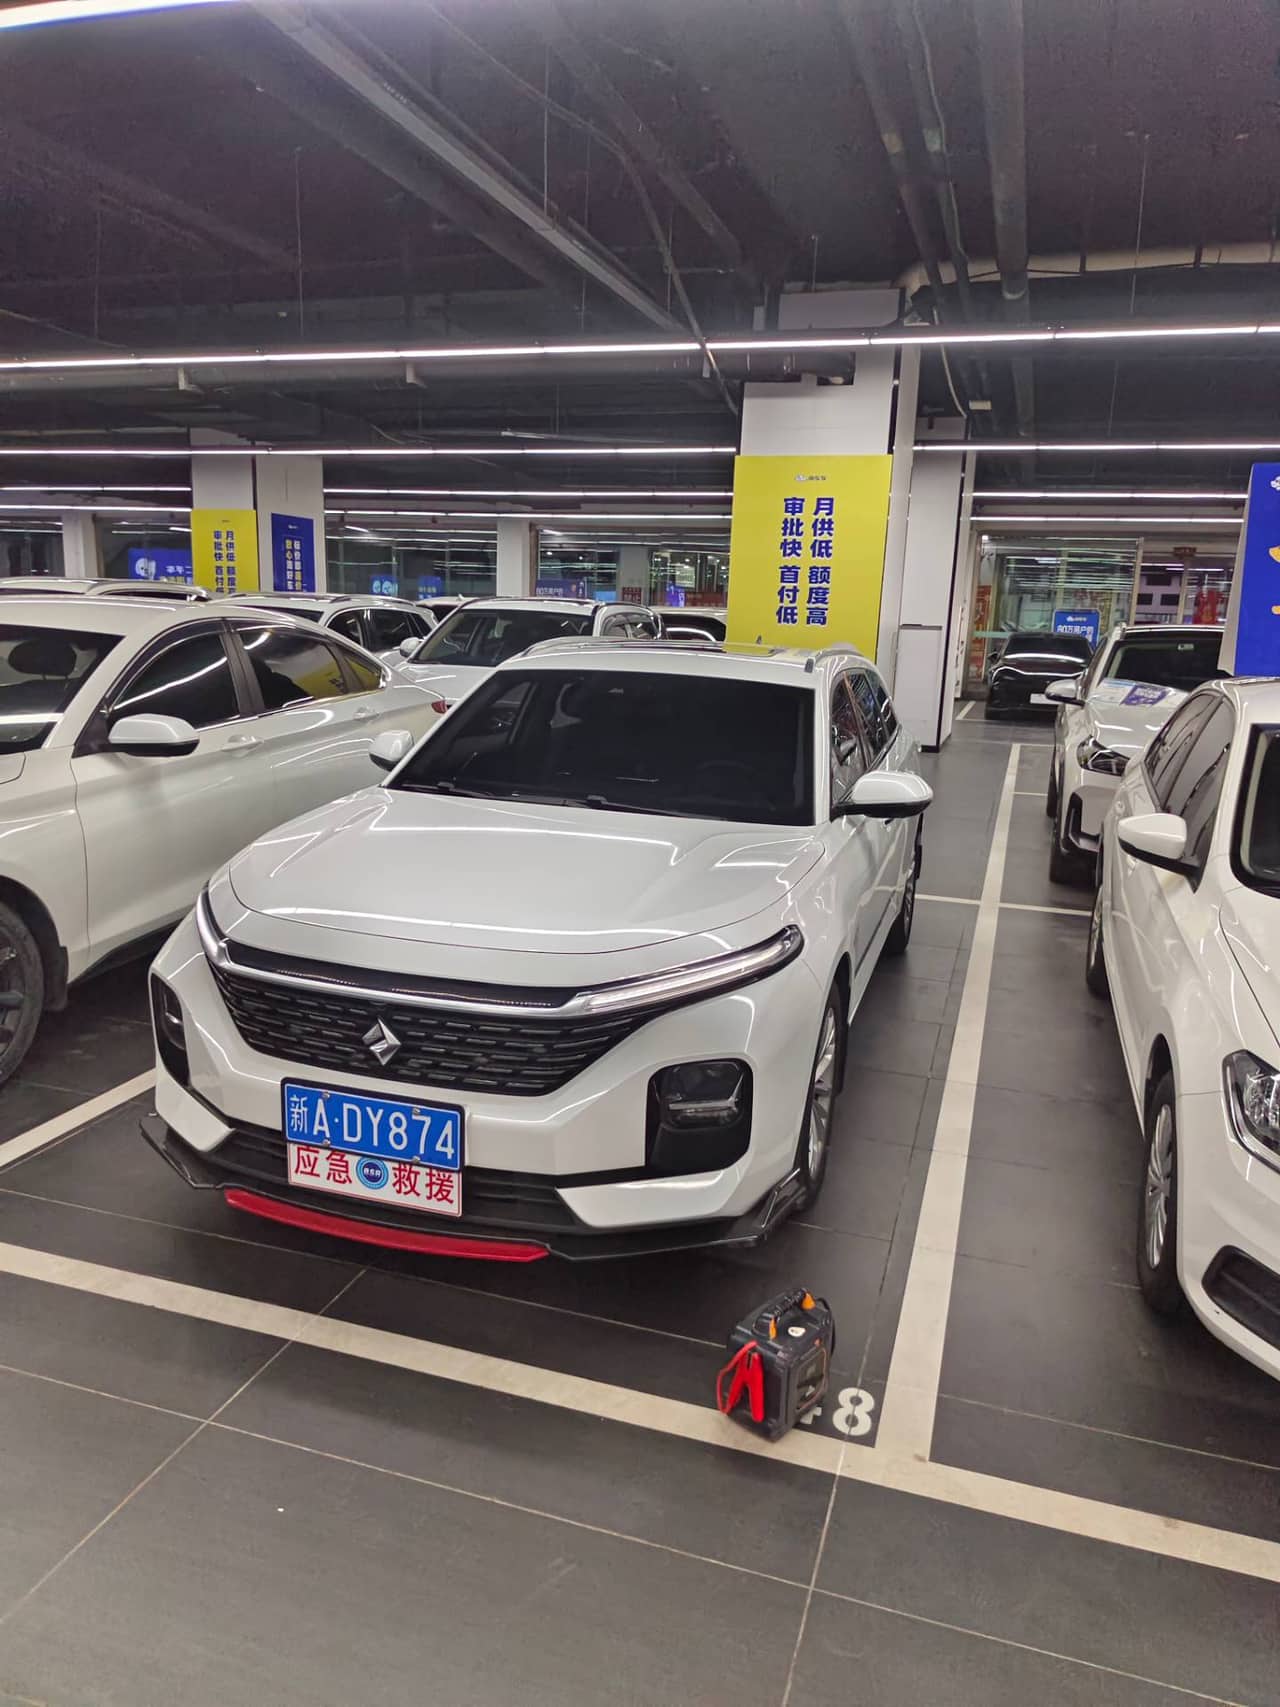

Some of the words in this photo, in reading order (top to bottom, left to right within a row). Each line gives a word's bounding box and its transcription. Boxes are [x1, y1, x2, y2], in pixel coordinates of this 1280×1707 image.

[780, 497, 805, 558] 审批快
[810, 497, 835, 559] 月供低
[776, 565, 801, 625] 首付低
[806, 566, 831, 626] 额度高
[290, 1094, 455, 1160] 新A·DY874
[294, 1145, 352, 1185] 应急
[392, 1162, 455, 1205] 救援
